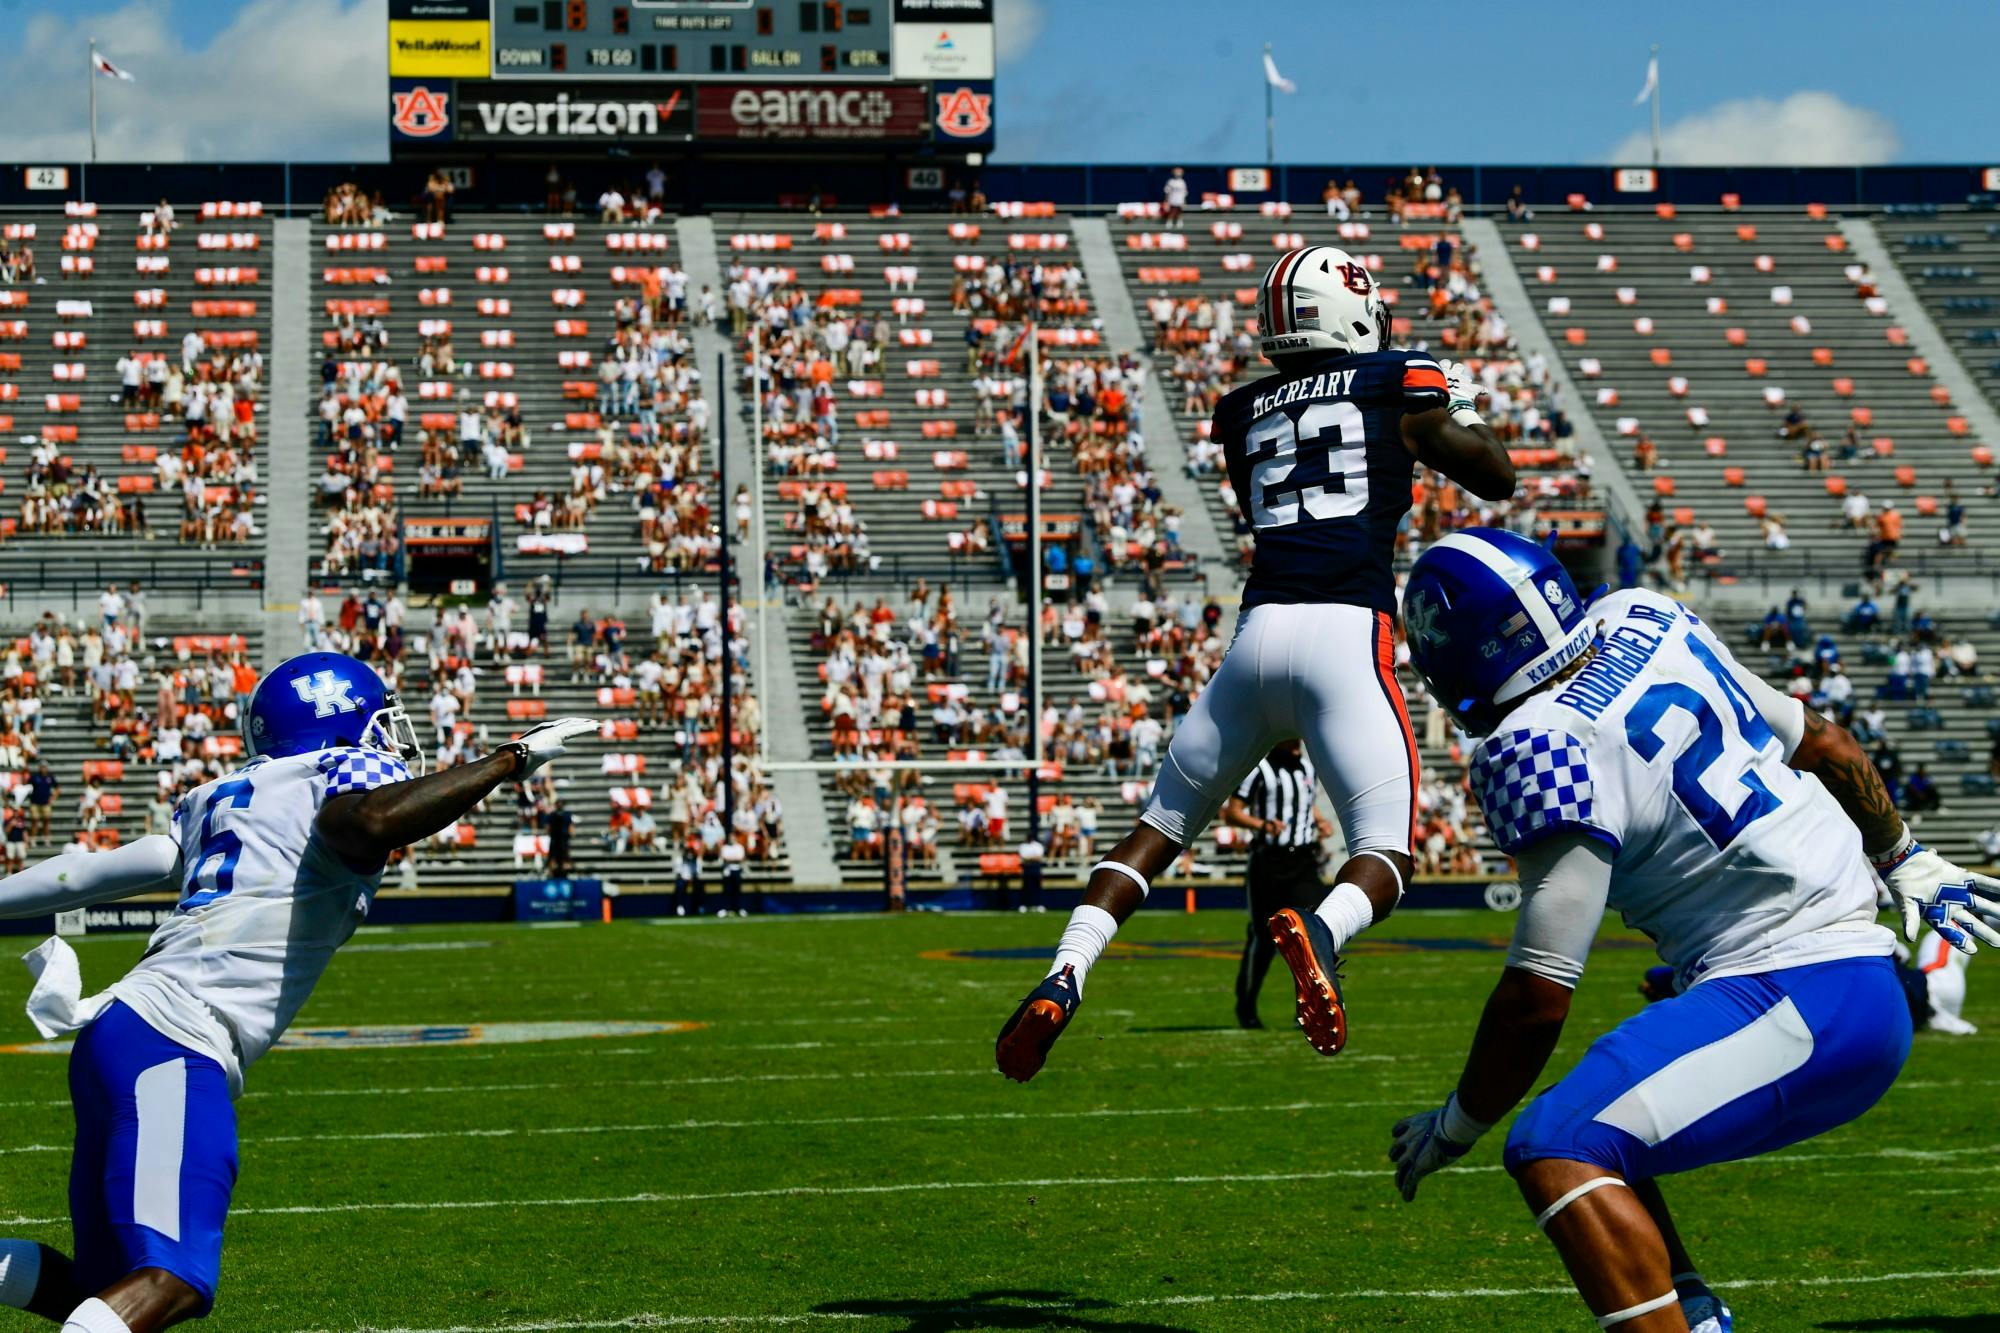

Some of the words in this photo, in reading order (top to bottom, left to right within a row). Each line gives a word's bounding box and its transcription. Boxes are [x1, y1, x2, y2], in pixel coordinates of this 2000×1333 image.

[655, 16, 678, 28] TIME
[680, 16, 705, 28] OUTS
[708, 16, 732, 28] LEFT
[396, 38, 481, 51] YellaWood
[499, 49, 542, 66] DOWN
[591, 49, 610, 66] TO
[612, 49, 632, 66] GO
[752, 49, 781, 66] BALL
[783, 49, 801, 66] ON
[477, 92, 659, 135] verizon
[730, 89, 862, 126] eamc
[38, 171, 55, 185] 42
[914, 171, 938, 185] 40
[1252, 368, 1357, 419] McCREARY
[1245, 401, 1370, 530] 23
[1481, 640, 1502, 659] 22
[1519, 634, 1534, 649] 24
[1526, 625, 1591, 685] KENTUCKY
[1554, 626, 1664, 722] RODRIGUEZ
[289, 669, 359, 719] UK
[1623, 630, 1784, 852] 24
[179, 777, 255, 912] 6
[86, 910, 120, 927] LOCAL
[122, 910, 154, 926] FORD
